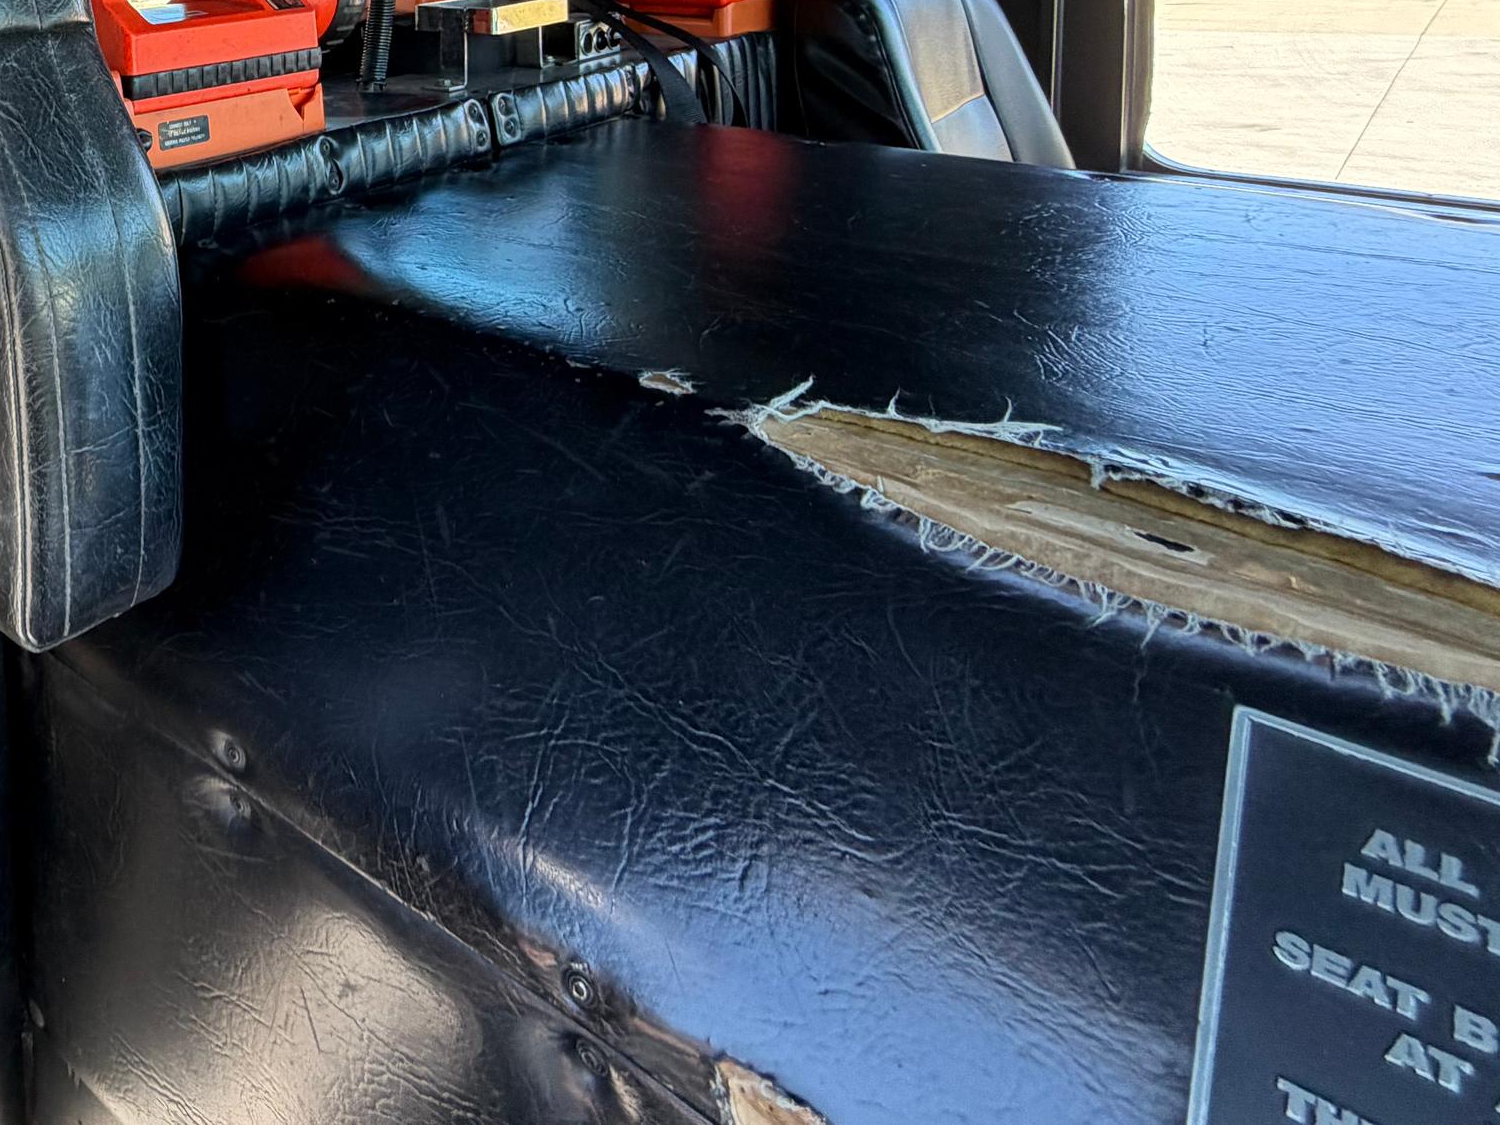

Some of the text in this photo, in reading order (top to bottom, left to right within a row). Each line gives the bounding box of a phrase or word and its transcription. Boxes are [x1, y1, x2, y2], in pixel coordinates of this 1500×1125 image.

[1361, 828, 1480, 898] ALL
[1342, 862, 1500, 956] MUST
[1272, 931, 1431, 1021] SEAT
[1385, 1033, 1475, 1095] AT
